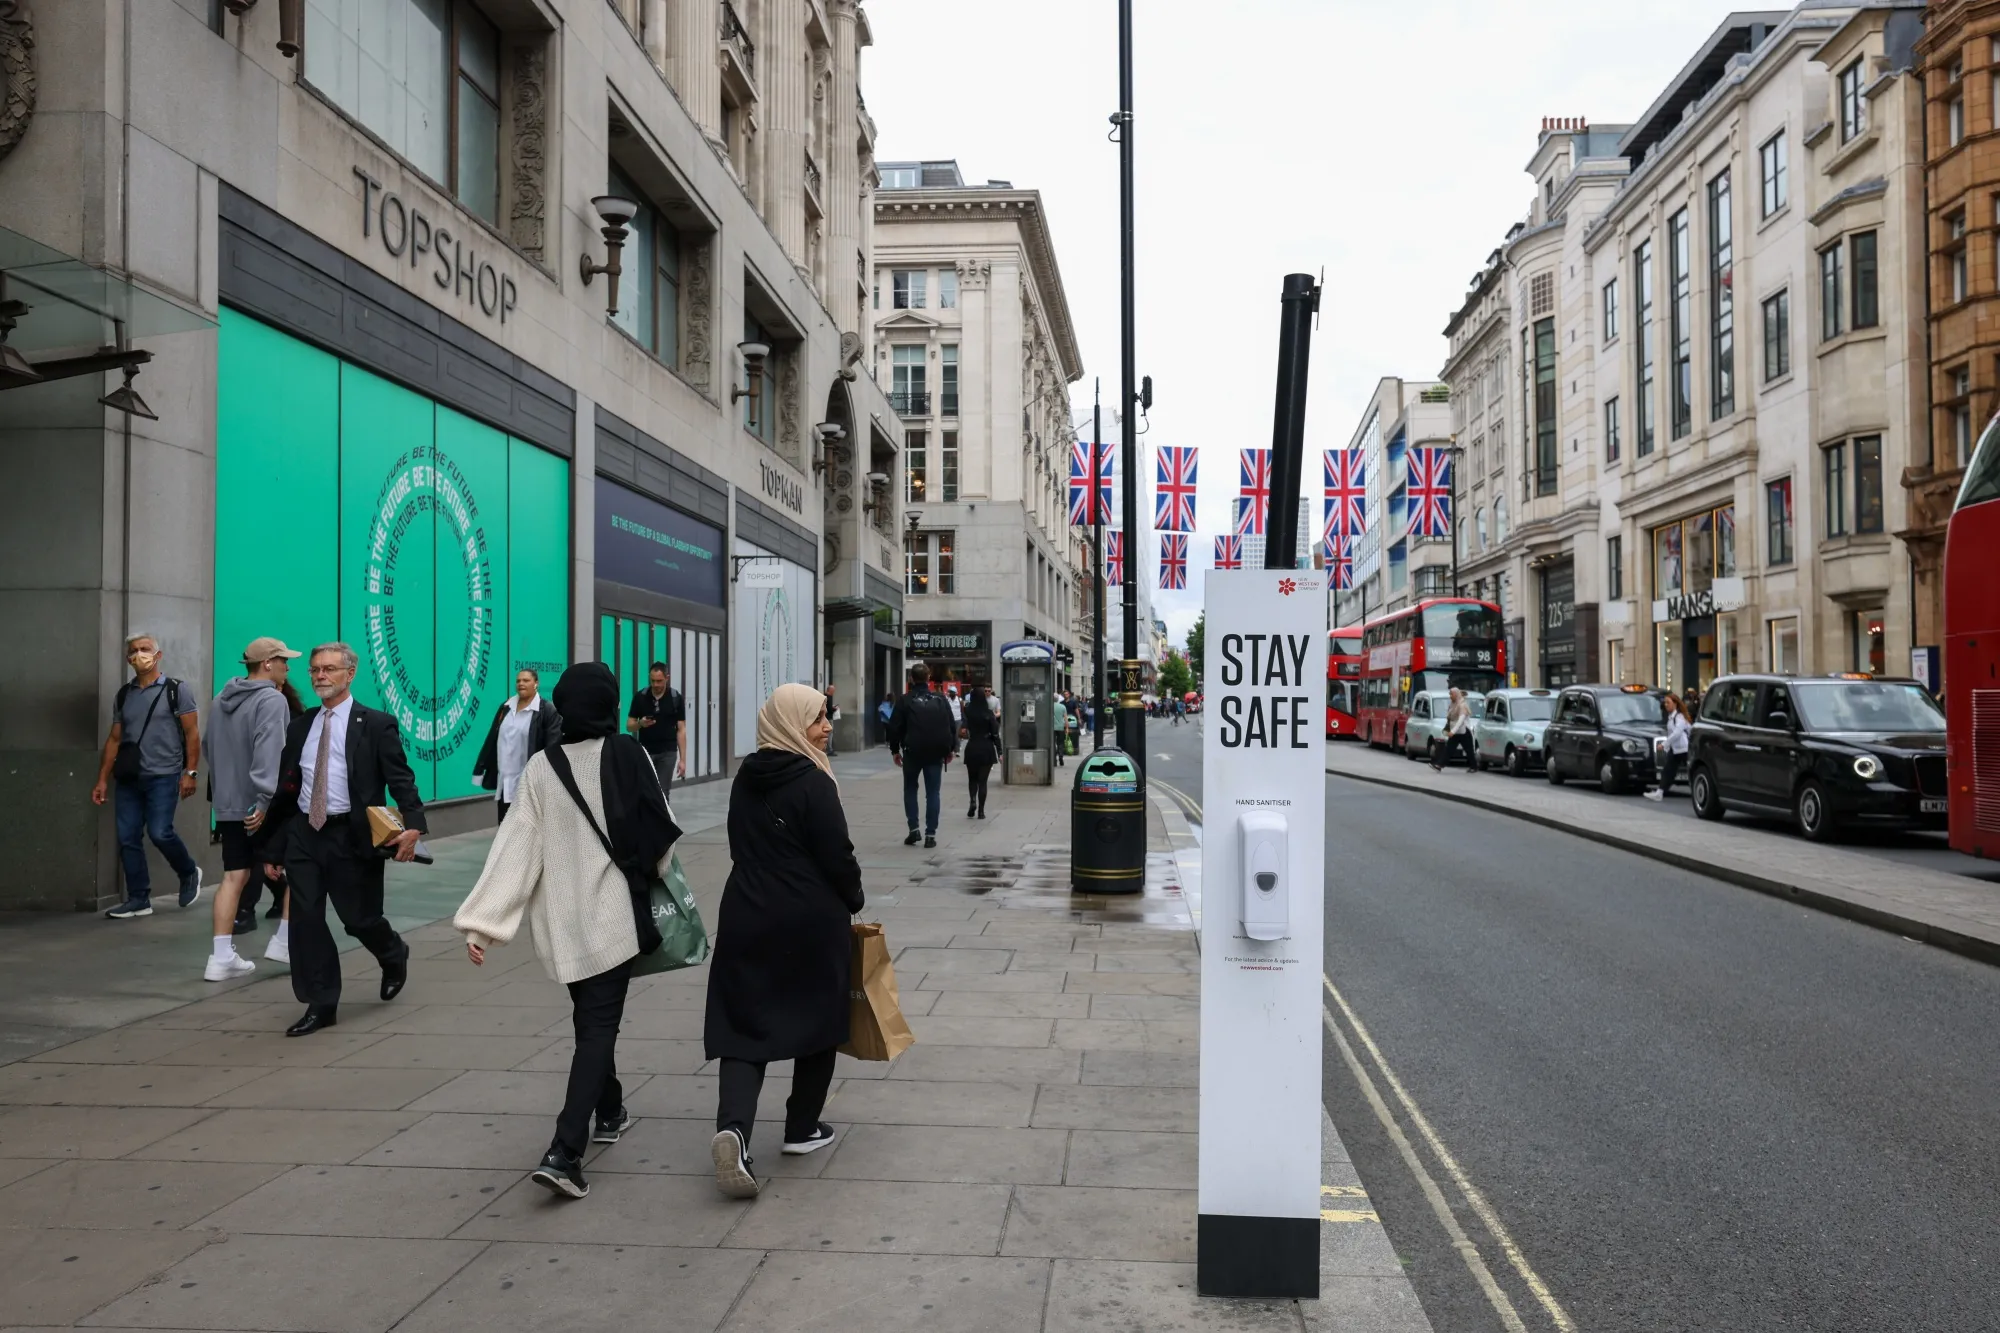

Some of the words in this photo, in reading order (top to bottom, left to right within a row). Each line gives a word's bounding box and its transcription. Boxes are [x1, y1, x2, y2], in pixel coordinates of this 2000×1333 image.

[353, 165, 517, 325] TOPSHOP
[412, 465, 424, 488] BE
[760, 458, 802, 515] TOPMAN
[381, 470, 412, 528] FUTURE
[442, 478, 470, 536] FUTURE
[371, 522, 387, 562] THE
[466, 536, 478, 563] BE
[369, 565, 380, 594] BE
[471, 562, 482, 601] THE
[1548, 602, 1562, 629] 225
[369, 604, 390, 685] FUTURE
[467, 607, 482, 680] FUTURE
[912, 633, 929, 641] VANS
[1477, 650, 1491, 662] 98
[1222, 633, 1310, 687] STAY
[1221, 696, 1308, 748] SAFE
[1256, 799, 1292, 807] SANITISER
